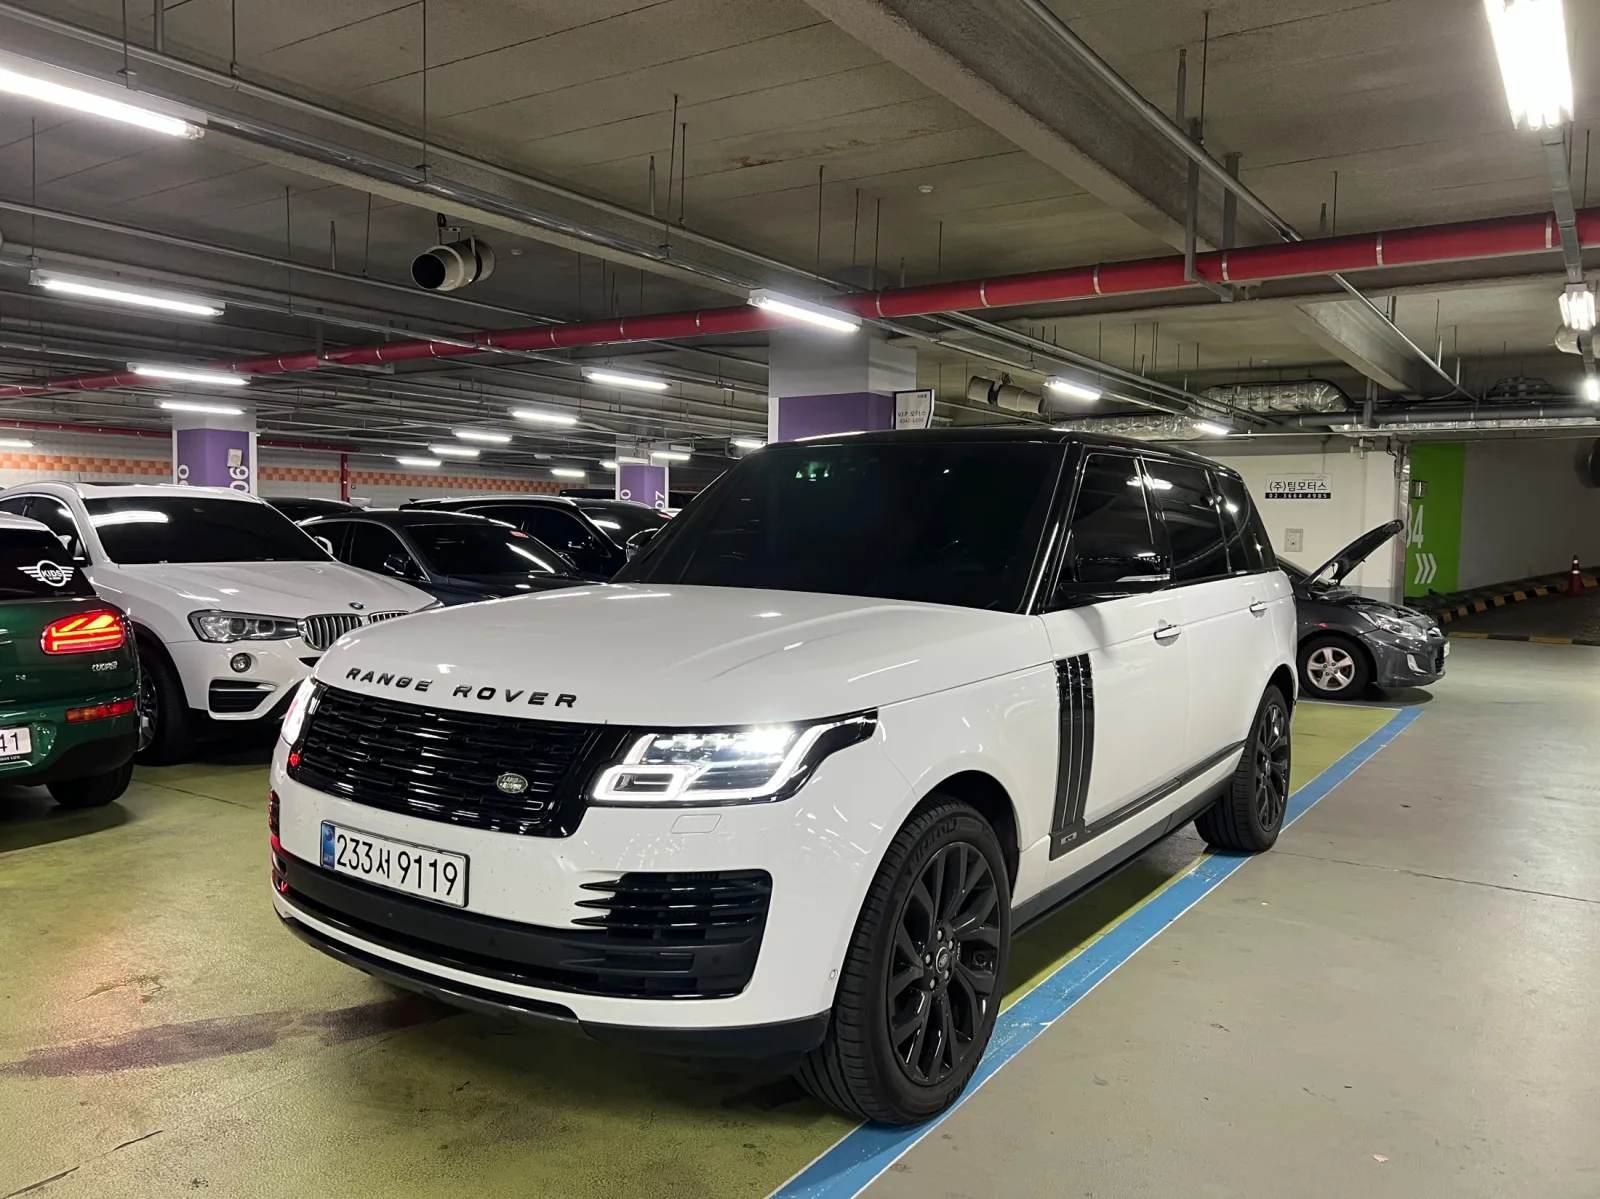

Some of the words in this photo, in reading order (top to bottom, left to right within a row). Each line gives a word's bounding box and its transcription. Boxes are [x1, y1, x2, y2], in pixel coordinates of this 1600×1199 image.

[1269, 481, 1328, 492] (주)팀모터스
[41, 569, 63, 579] KIDS
[345, 667, 433, 692] RANGE
[452, 683, 577, 708] ROVER
